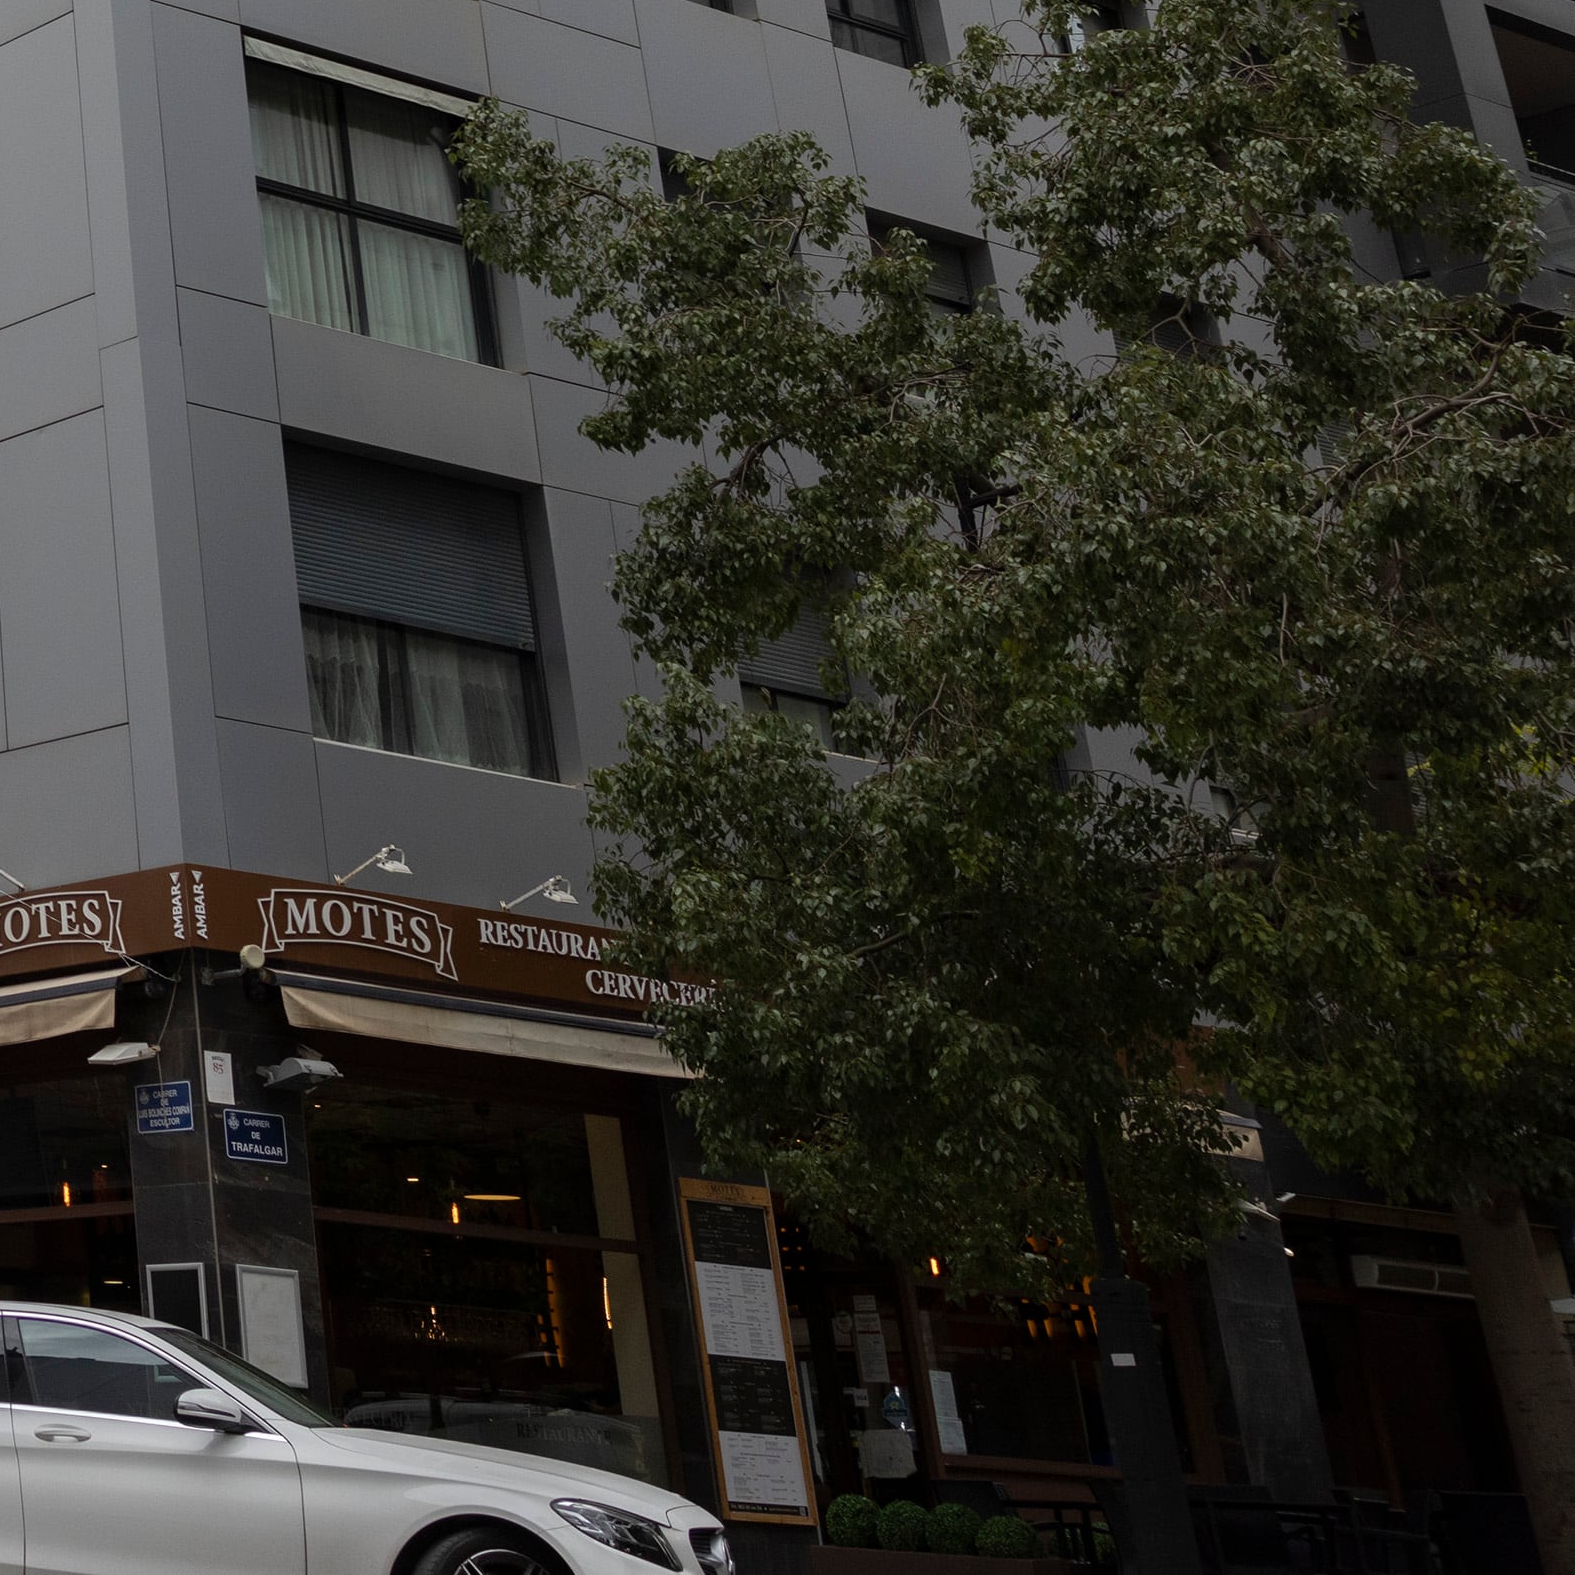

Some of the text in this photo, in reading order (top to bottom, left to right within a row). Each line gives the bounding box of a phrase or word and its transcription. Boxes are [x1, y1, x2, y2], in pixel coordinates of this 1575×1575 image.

[170, 881, 186, 941] AMBAR
[191, 881, 209, 940] AMBAR
[283, 896, 433, 955] MOTES
[477, 918, 619, 963] RESTAURA
[243, 1117, 271, 1129] CARRER
[251, 1131, 262, 1141] DE
[231, 1141, 284, 1157] TRAFALGAR
